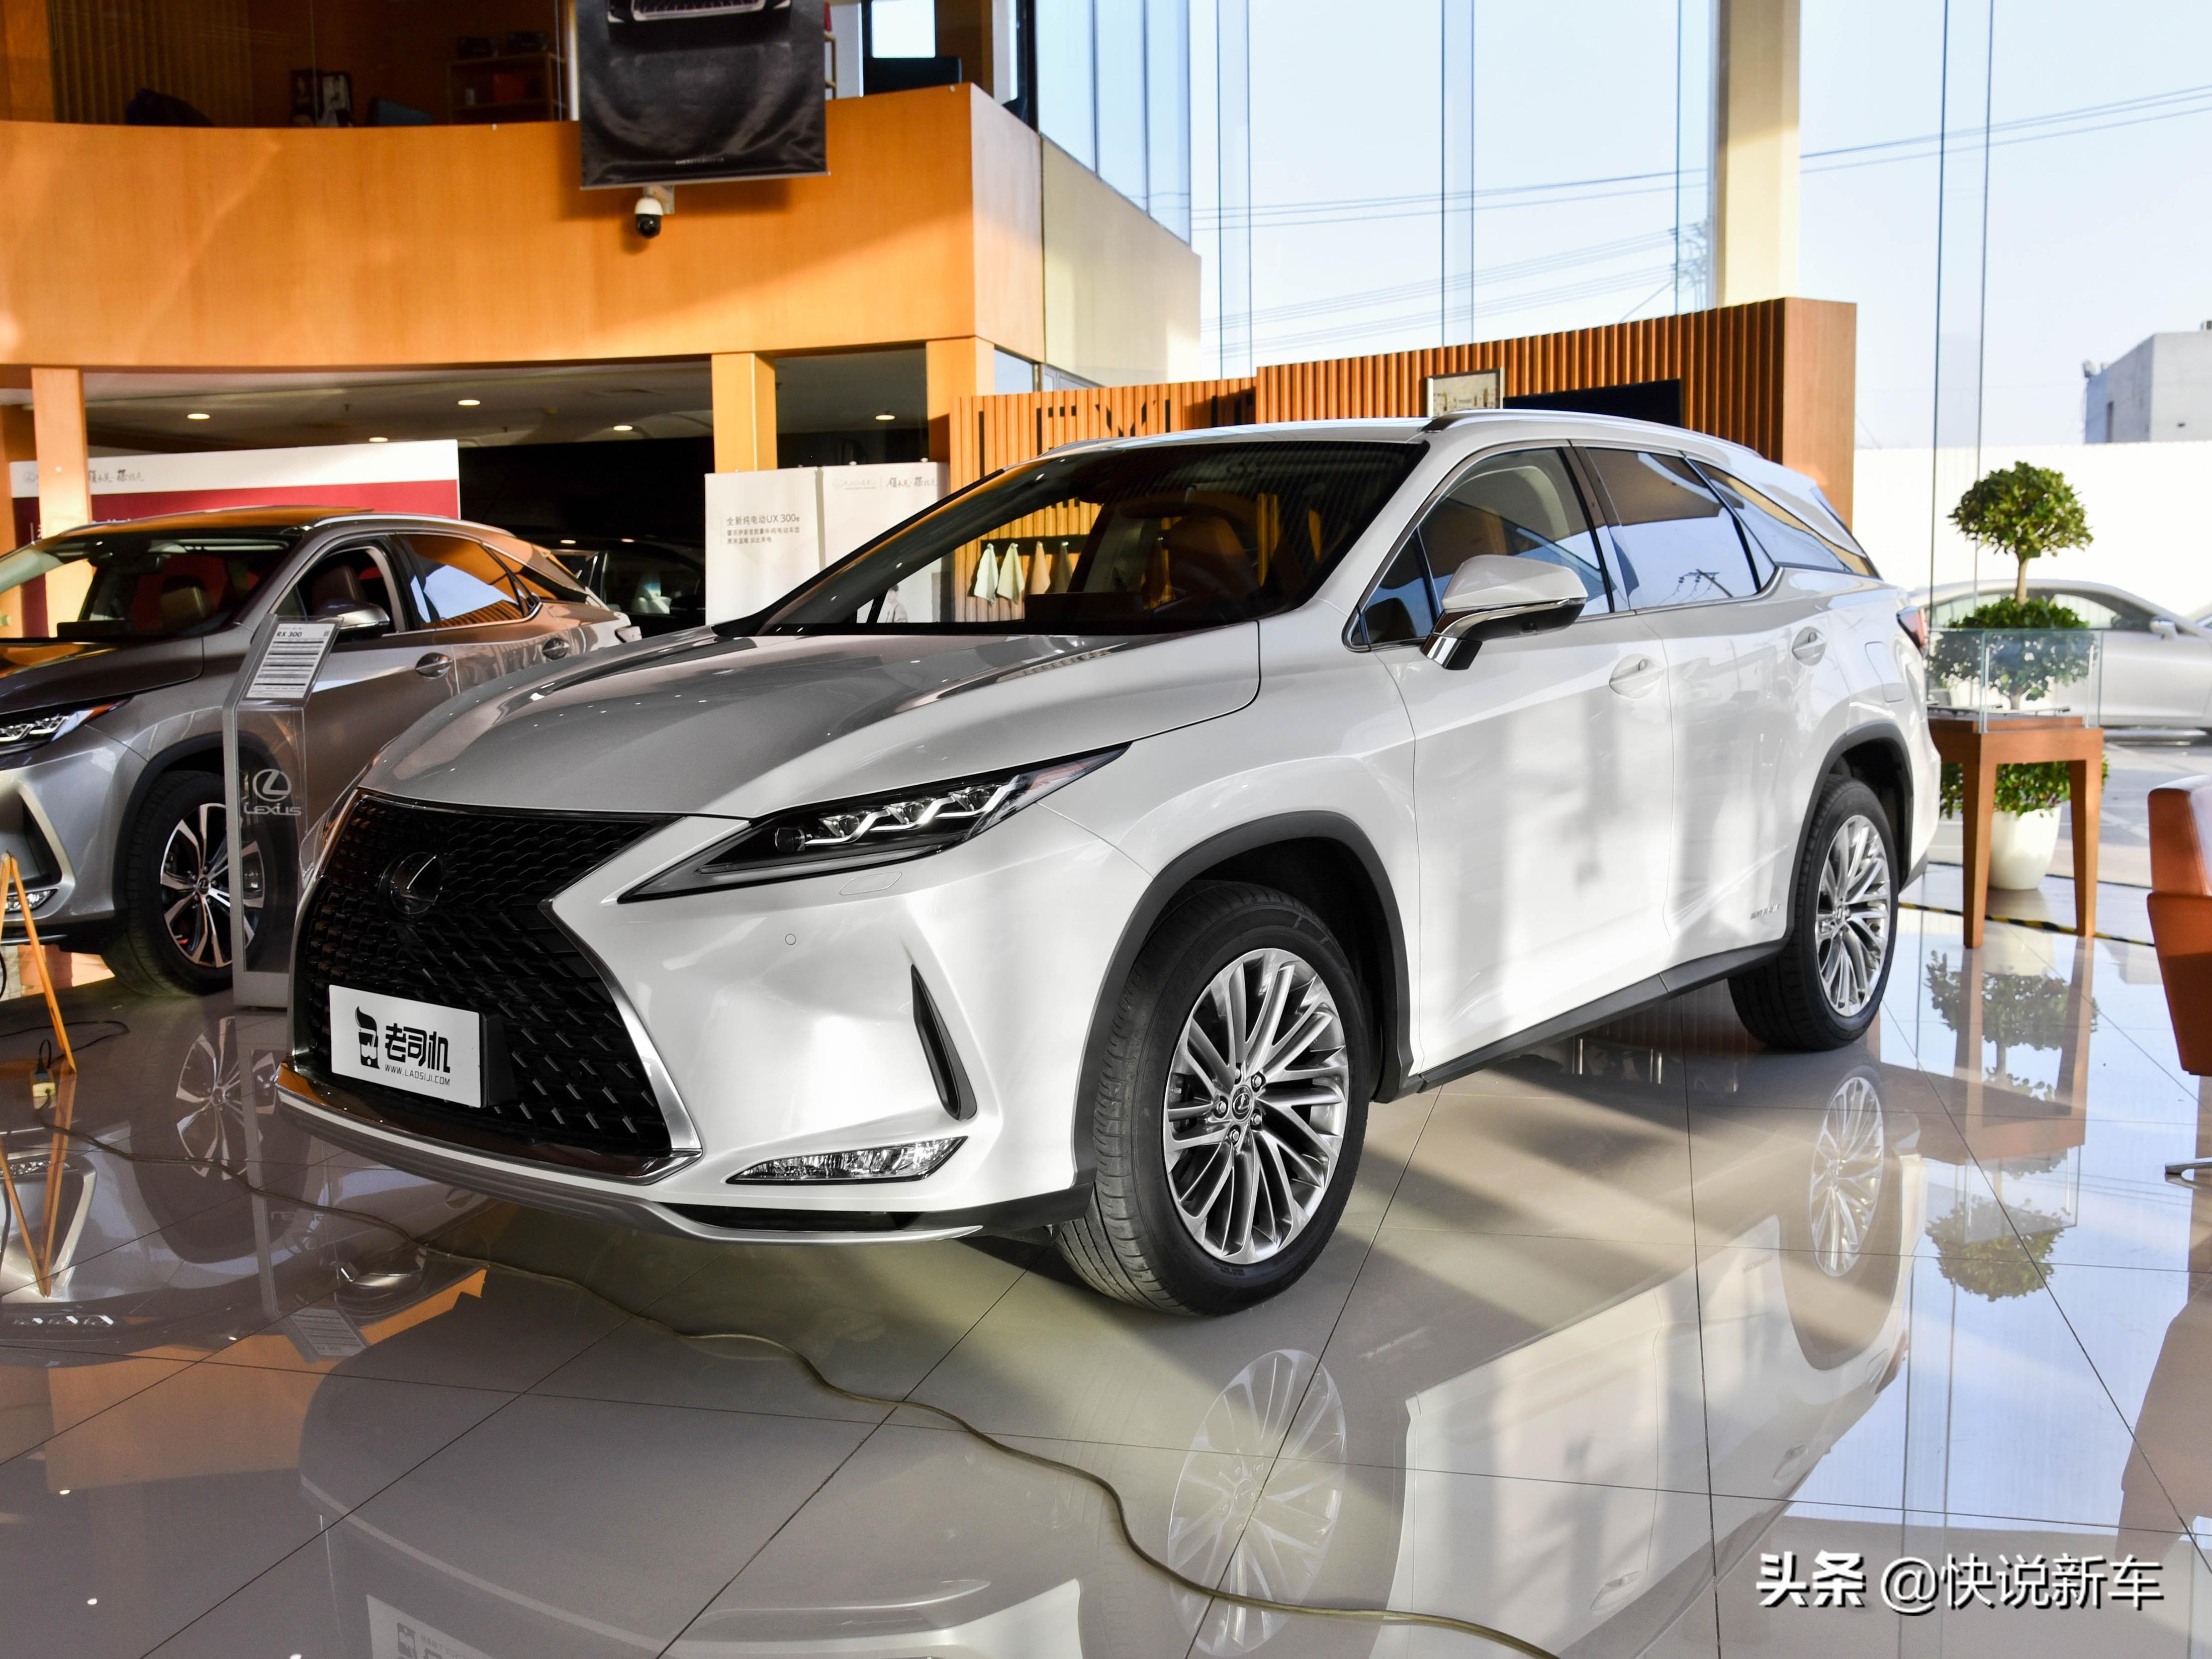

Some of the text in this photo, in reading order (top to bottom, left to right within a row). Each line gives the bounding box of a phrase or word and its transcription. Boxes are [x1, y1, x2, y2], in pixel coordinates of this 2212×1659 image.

[780, 513, 800, 522] 300e
[244, 803, 302, 816] LEXUS
[385, 1023, 450, 1073] 老司机
[385, 1064, 450, 1086] WWW.LAOSIJI.COM
